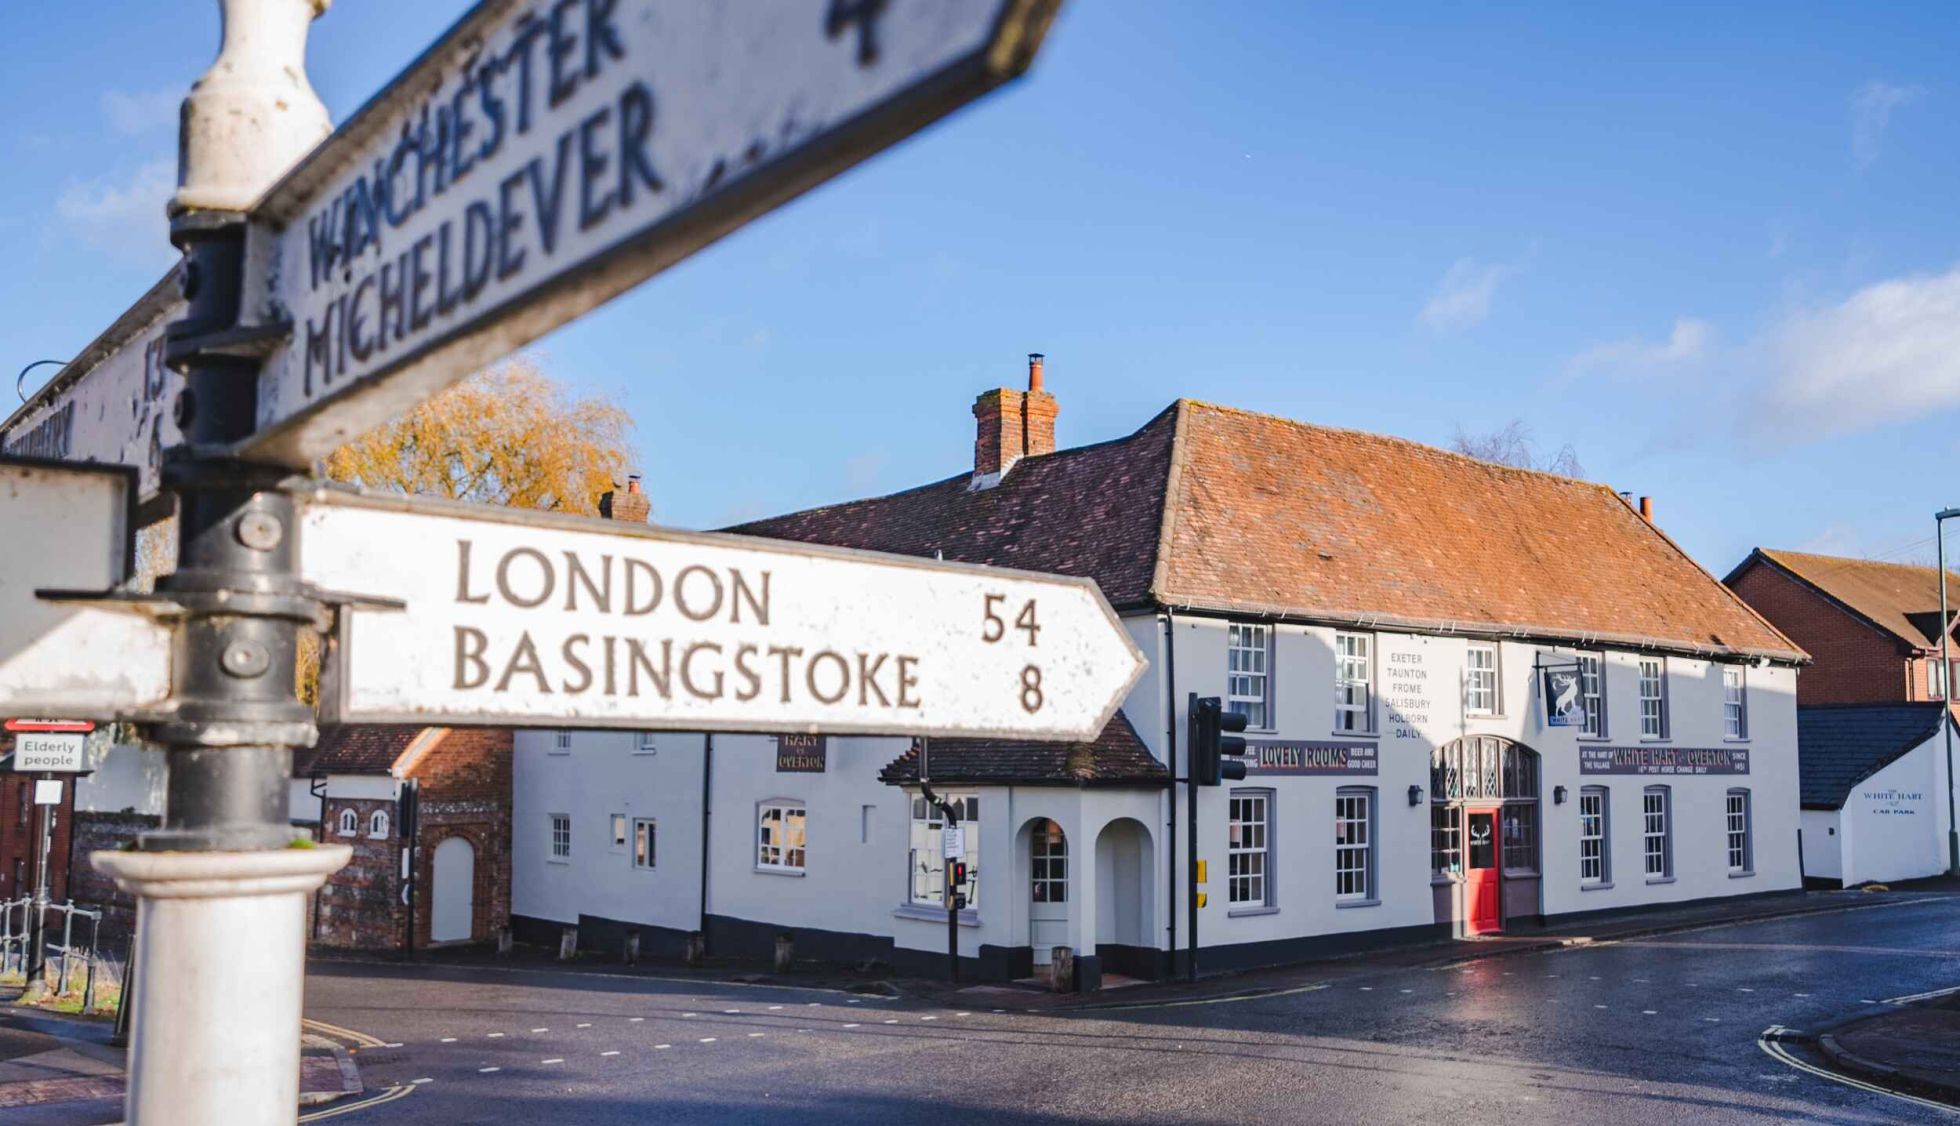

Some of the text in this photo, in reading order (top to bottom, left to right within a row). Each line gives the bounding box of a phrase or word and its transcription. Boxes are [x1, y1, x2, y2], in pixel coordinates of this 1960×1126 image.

[309, 0, 625, 290] WINCHESTER
[304, 79, 663, 397] MICHELDEVER
[455, 539, 1041, 647] LONDON 54
[1391, 653, 1423, 663] EXETER
[453, 625, 1043, 714] BASINGSTOKE 8
[1387, 667, 1427, 679] TAUNTON
[1392, 683, 1422, 694] FROME
[1385, 698, 1431, 709] SALISBURY
[1389, 714, 1428, 723] HOLBORN
[1396, 729, 1421, 738] DAILY
[24, 741, 75, 754] Elderly
[1350, 748, 1375, 756] BEER AND
[24, 755, 73, 766] people
[779, 755, 824, 768] OVERTON
[1260, 746, 1348, 769] LOVELY ROOMS
[1613, 748, 1648, 766] WHITE
[1651, 748, 1678, 766] HART
[1687, 749, 1730, 767] OVERTON
[1347, 760, 1360, 768] GOOD
